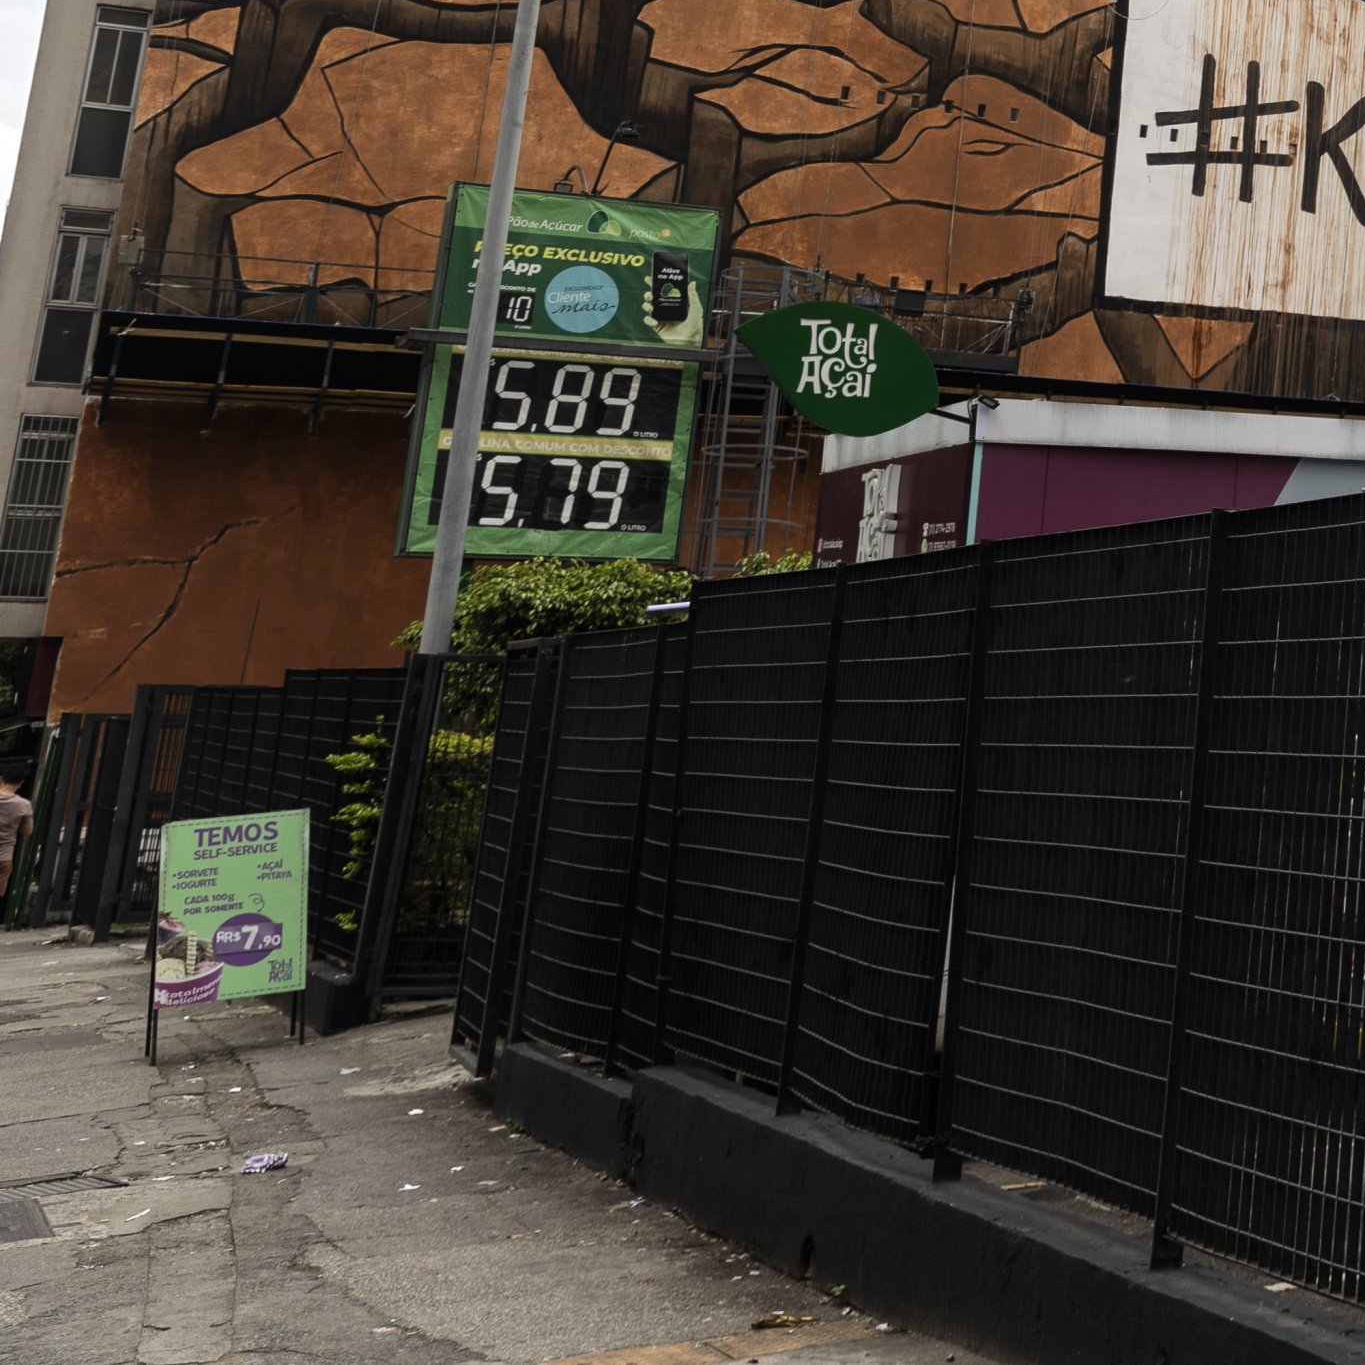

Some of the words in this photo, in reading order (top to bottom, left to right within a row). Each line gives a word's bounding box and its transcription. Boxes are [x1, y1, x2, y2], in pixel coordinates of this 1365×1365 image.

[474, 240, 539, 259] PEÇO
[542, 247, 645, 267] EXCLUSIVO
[502, 259, 542, 276] App
[547, 291, 592, 304] Cliente
[552, 299, 616, 314] mais
[800, 318, 879, 369] Total
[492, 360, 642, 436] 5,89
[514, 439, 567, 452] COMUM
[569, 443, 600, 454] COM
[602, 444, 672, 458] DESCONTO
[478, 455, 630, 530] 5,79
[193, 821, 279, 848] TEMOS
[193, 842, 278, 861] SELF-SERVICE
[184, 895, 209, 905] CADA
[212, 893, 236, 902] 100g
[183, 906, 202, 916] POR
[204, 902, 244, 914] SOMENTE
